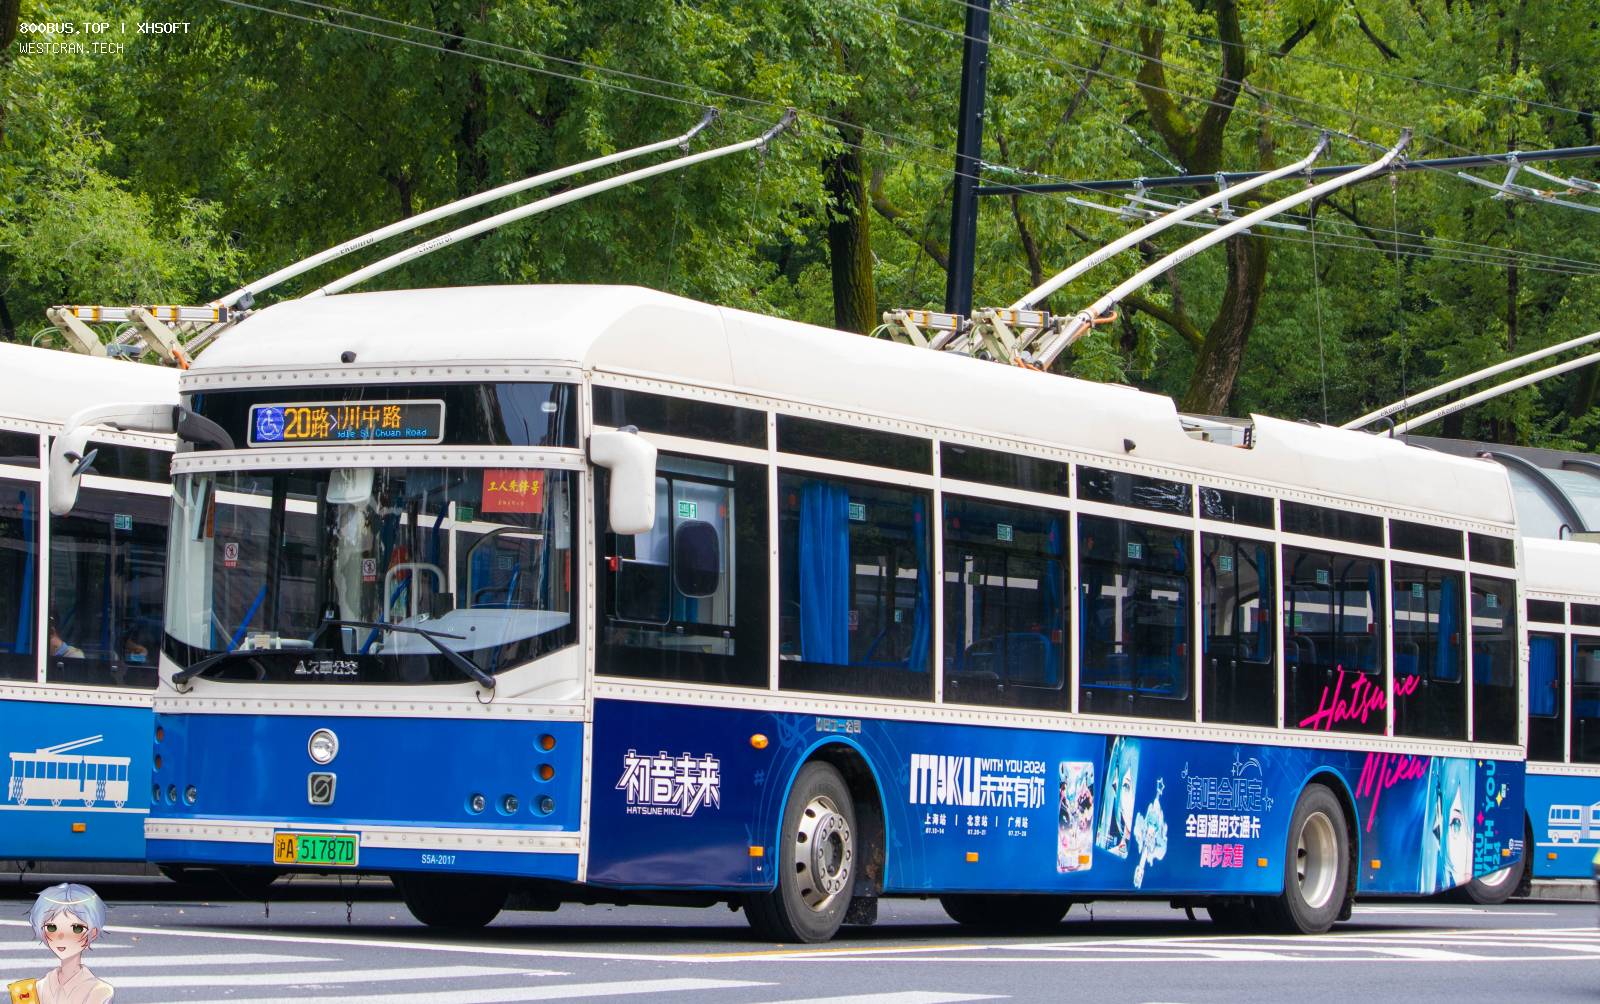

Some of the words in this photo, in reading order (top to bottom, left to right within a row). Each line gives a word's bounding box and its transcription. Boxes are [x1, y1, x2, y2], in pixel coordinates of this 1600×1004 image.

[284, 406, 330, 439] 20路
[337, 405, 402, 430] 川中路
[375, 429, 401, 438] Chuan
[405, 428, 428, 438] Road
[487, 479, 540, 497] 工人先锋号
[981, 758, 1004, 773] WITH
[1005, 759, 1023, 774] YOU
[1023, 760, 1046, 774] 2024
[615, 748, 721, 817] 初音未来
[909, 753, 981, 806] MIKU
[1485, 760, 1497, 812] YOU
[980, 775, 1046, 809] 未来有你
[626, 806, 663, 815] HATSUNE
[663, 807, 681, 816] MIKU
[924, 812, 947, 826] 上海站
[966, 814, 988, 827] 北京站
[1007, 816, 1029, 829] 广州站
[1185, 814, 1261, 839] 全国通用交通卡
[301, 839, 354, 861] 51787D
[421, 854, 456, 865] S5A-2017
[1199, 844, 1245, 868] 同步发售
